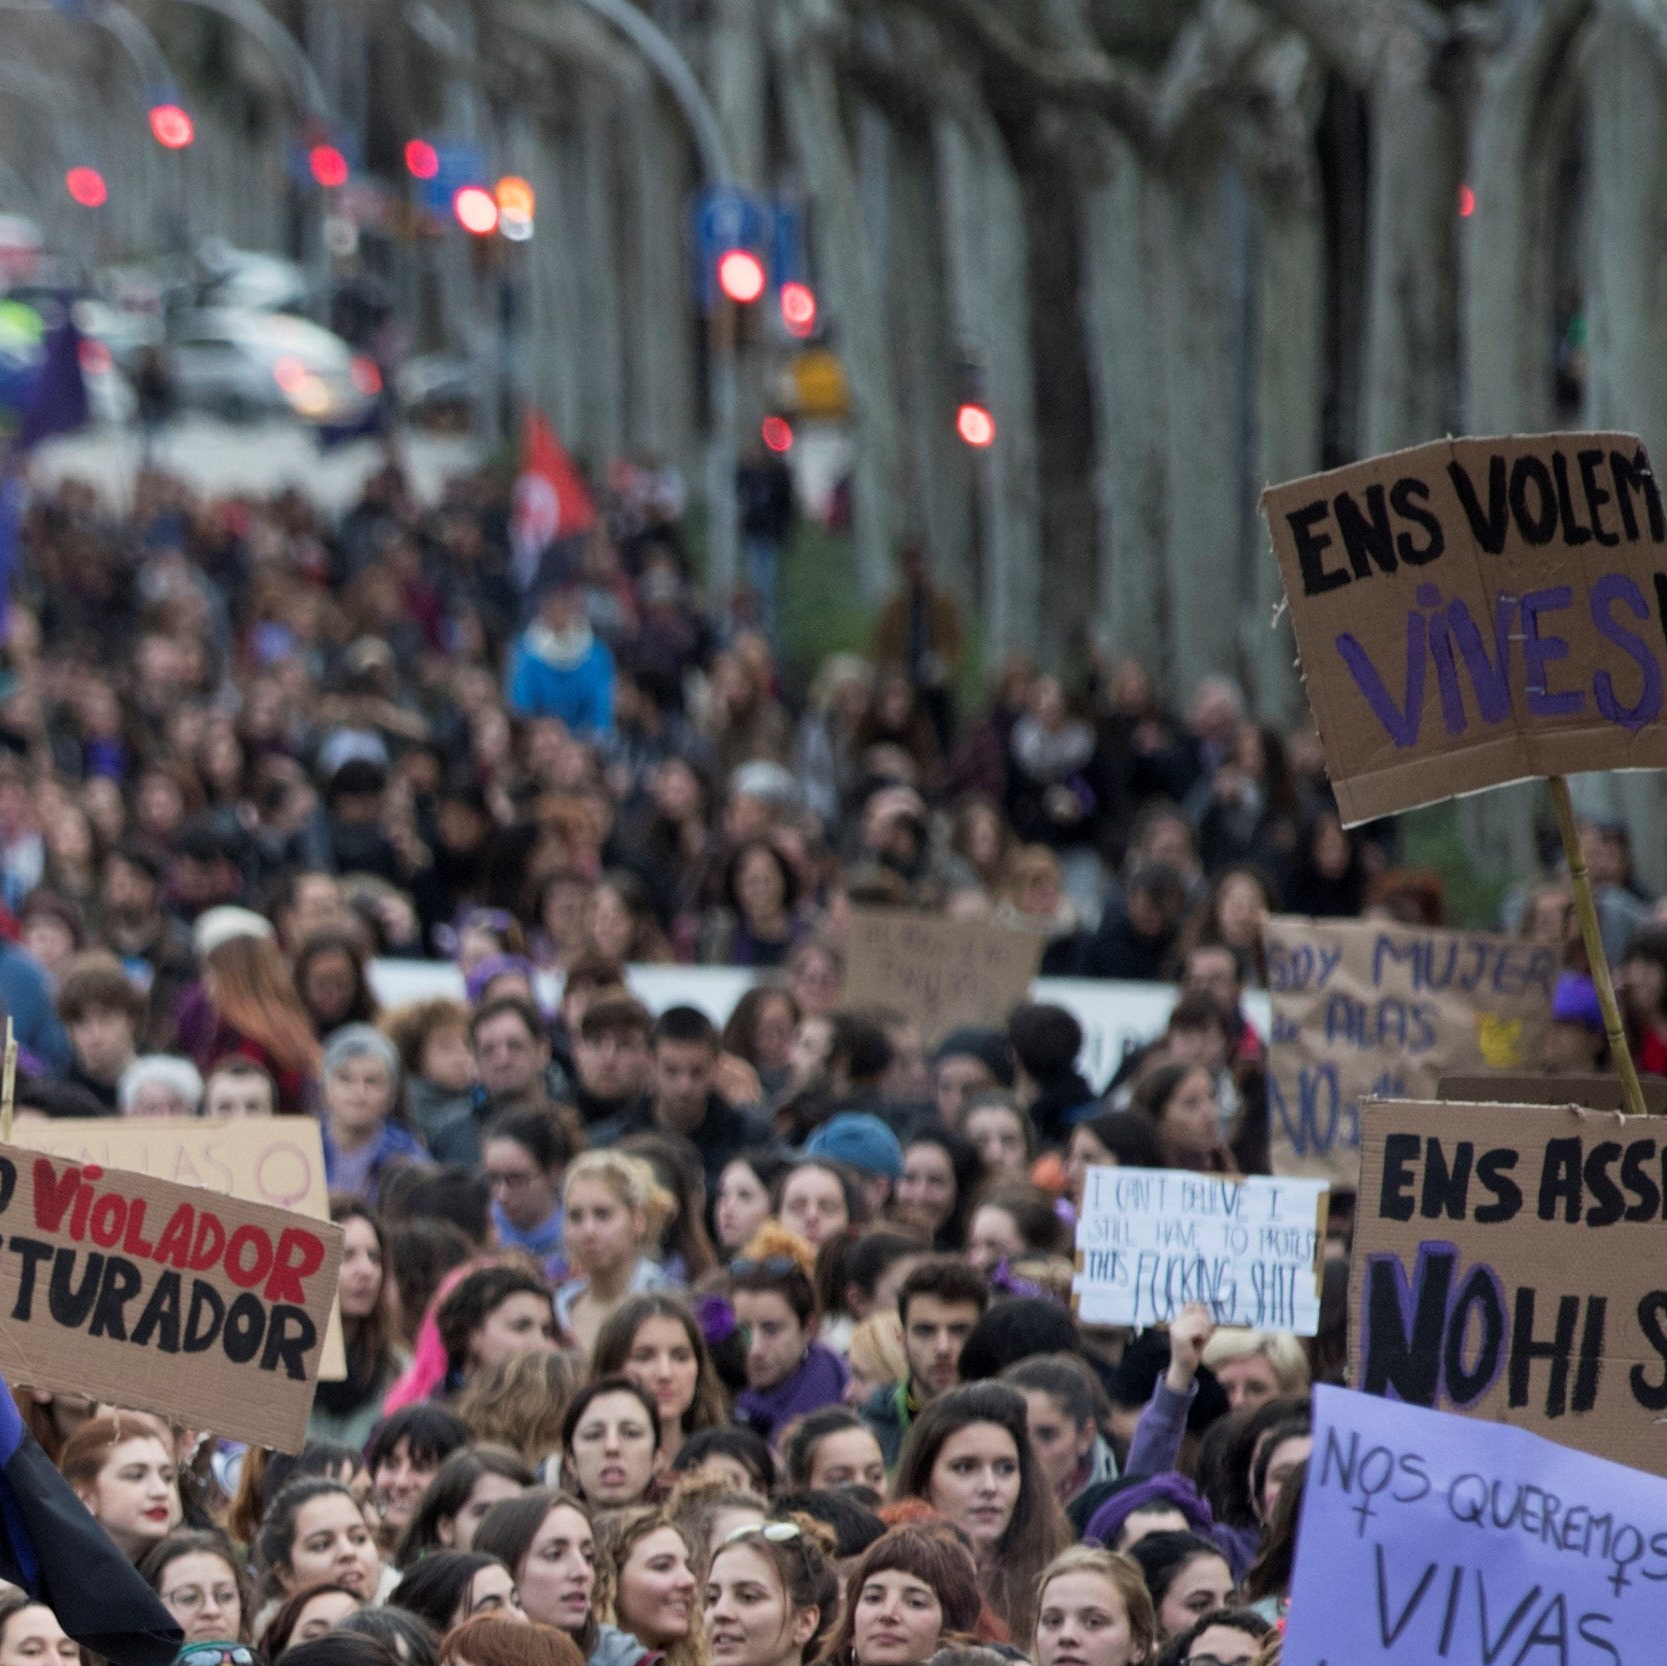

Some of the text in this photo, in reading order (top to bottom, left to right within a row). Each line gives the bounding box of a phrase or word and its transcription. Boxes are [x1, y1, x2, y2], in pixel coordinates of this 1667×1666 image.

[1286, 445, 1667, 596] ENS VOLEM
[1372, 934, 1559, 995] MUJER
[1327, 994, 1437, 1055] ALAS
[1268, 1062, 1339, 1157] NO
[1093, 1172, 1103, 1211] I
[1116, 1177, 1166, 1214] CAN'T
[1268, 1187, 1284, 1222] I
[1379, 1133, 1667, 1228] ENS ASS
[1087, 1218, 1136, 1247] STILL
[1156, 1220, 1202, 1250] HAVE
[1224, 1224, 1248, 1256] TO
[1088, 1250, 1302, 1328] THIS FUCKING SHIT
[1359, 1240, 1510, 1411] NO
[1508, 1286, 1608, 1419] HI
[1319, 1425, 1667, 1596] NOS QUEREMOS
